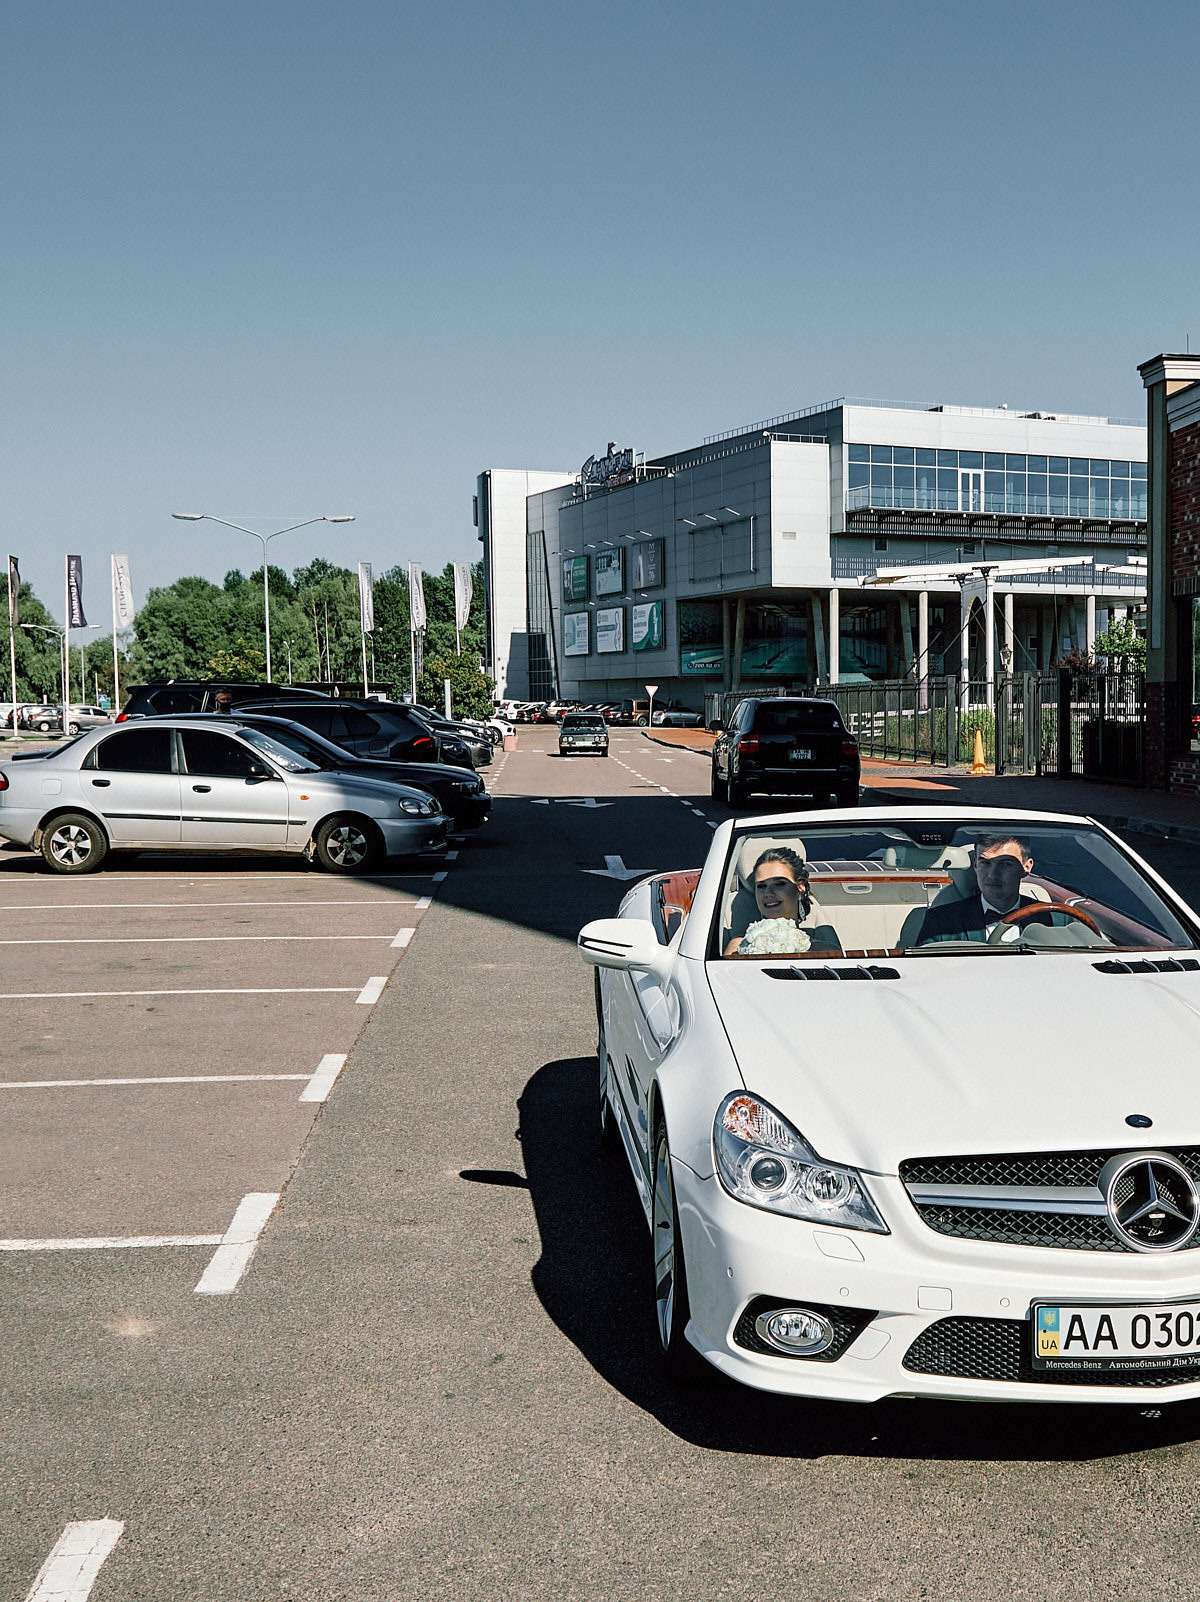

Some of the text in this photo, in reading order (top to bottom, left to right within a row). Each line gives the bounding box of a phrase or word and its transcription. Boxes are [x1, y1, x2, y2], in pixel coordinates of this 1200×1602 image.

[71, 587, 80, 624] DIAMOND
[1063, 1314, 1119, 1350] AA
[1041, 1340, 1058, 1350] UA
[1045, 1360, 1102, 1370] Mercedes-Benz
[1109, 1358, 1171, 1369] Автомобільний
[1172, 1357, 1188, 1368] Дім
